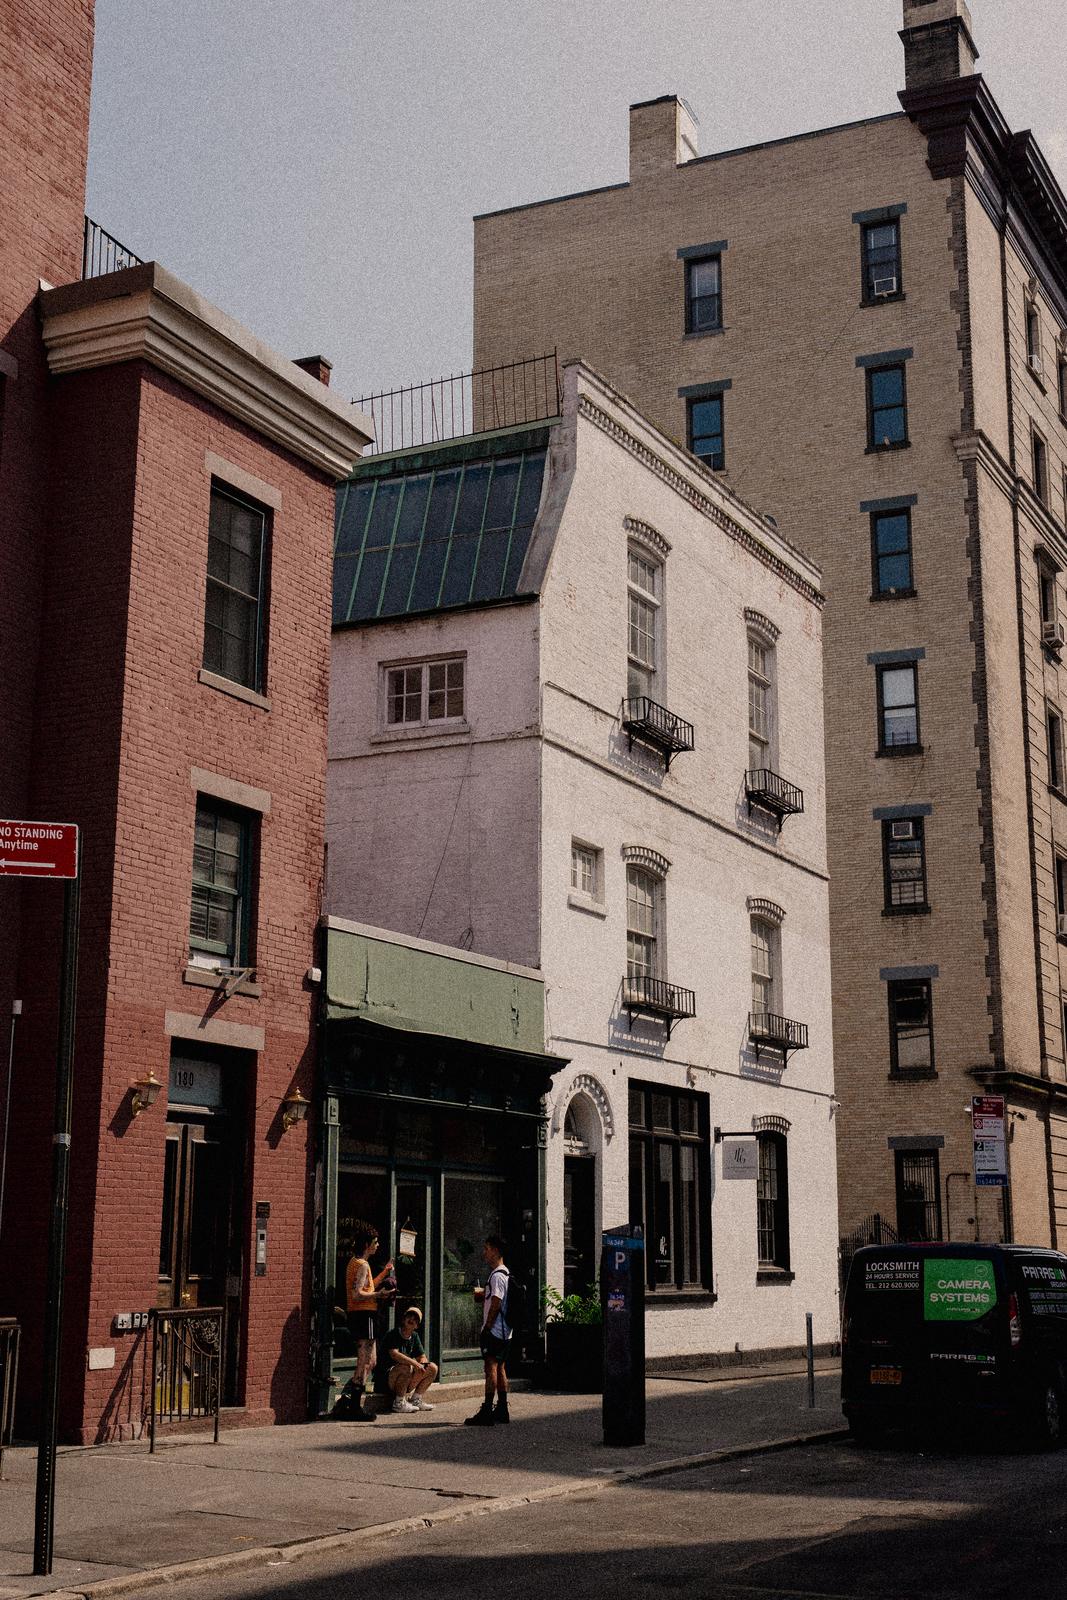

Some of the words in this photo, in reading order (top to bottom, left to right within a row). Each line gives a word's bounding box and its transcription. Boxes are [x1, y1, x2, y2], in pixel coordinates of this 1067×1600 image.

[0, 827, 12, 837] NO
[14, 827, 64, 840] STANDING
[0, 839, 39, 852] Anytime
[615, 1251, 626, 1270] P
[865, 1261, 920, 1272] LOCKSMITH
[937, 1279, 991, 1290] CAMERA
[930, 1293, 990, 1303] SYSTEMS
[930, 1353, 996, 1361] PARAGON
